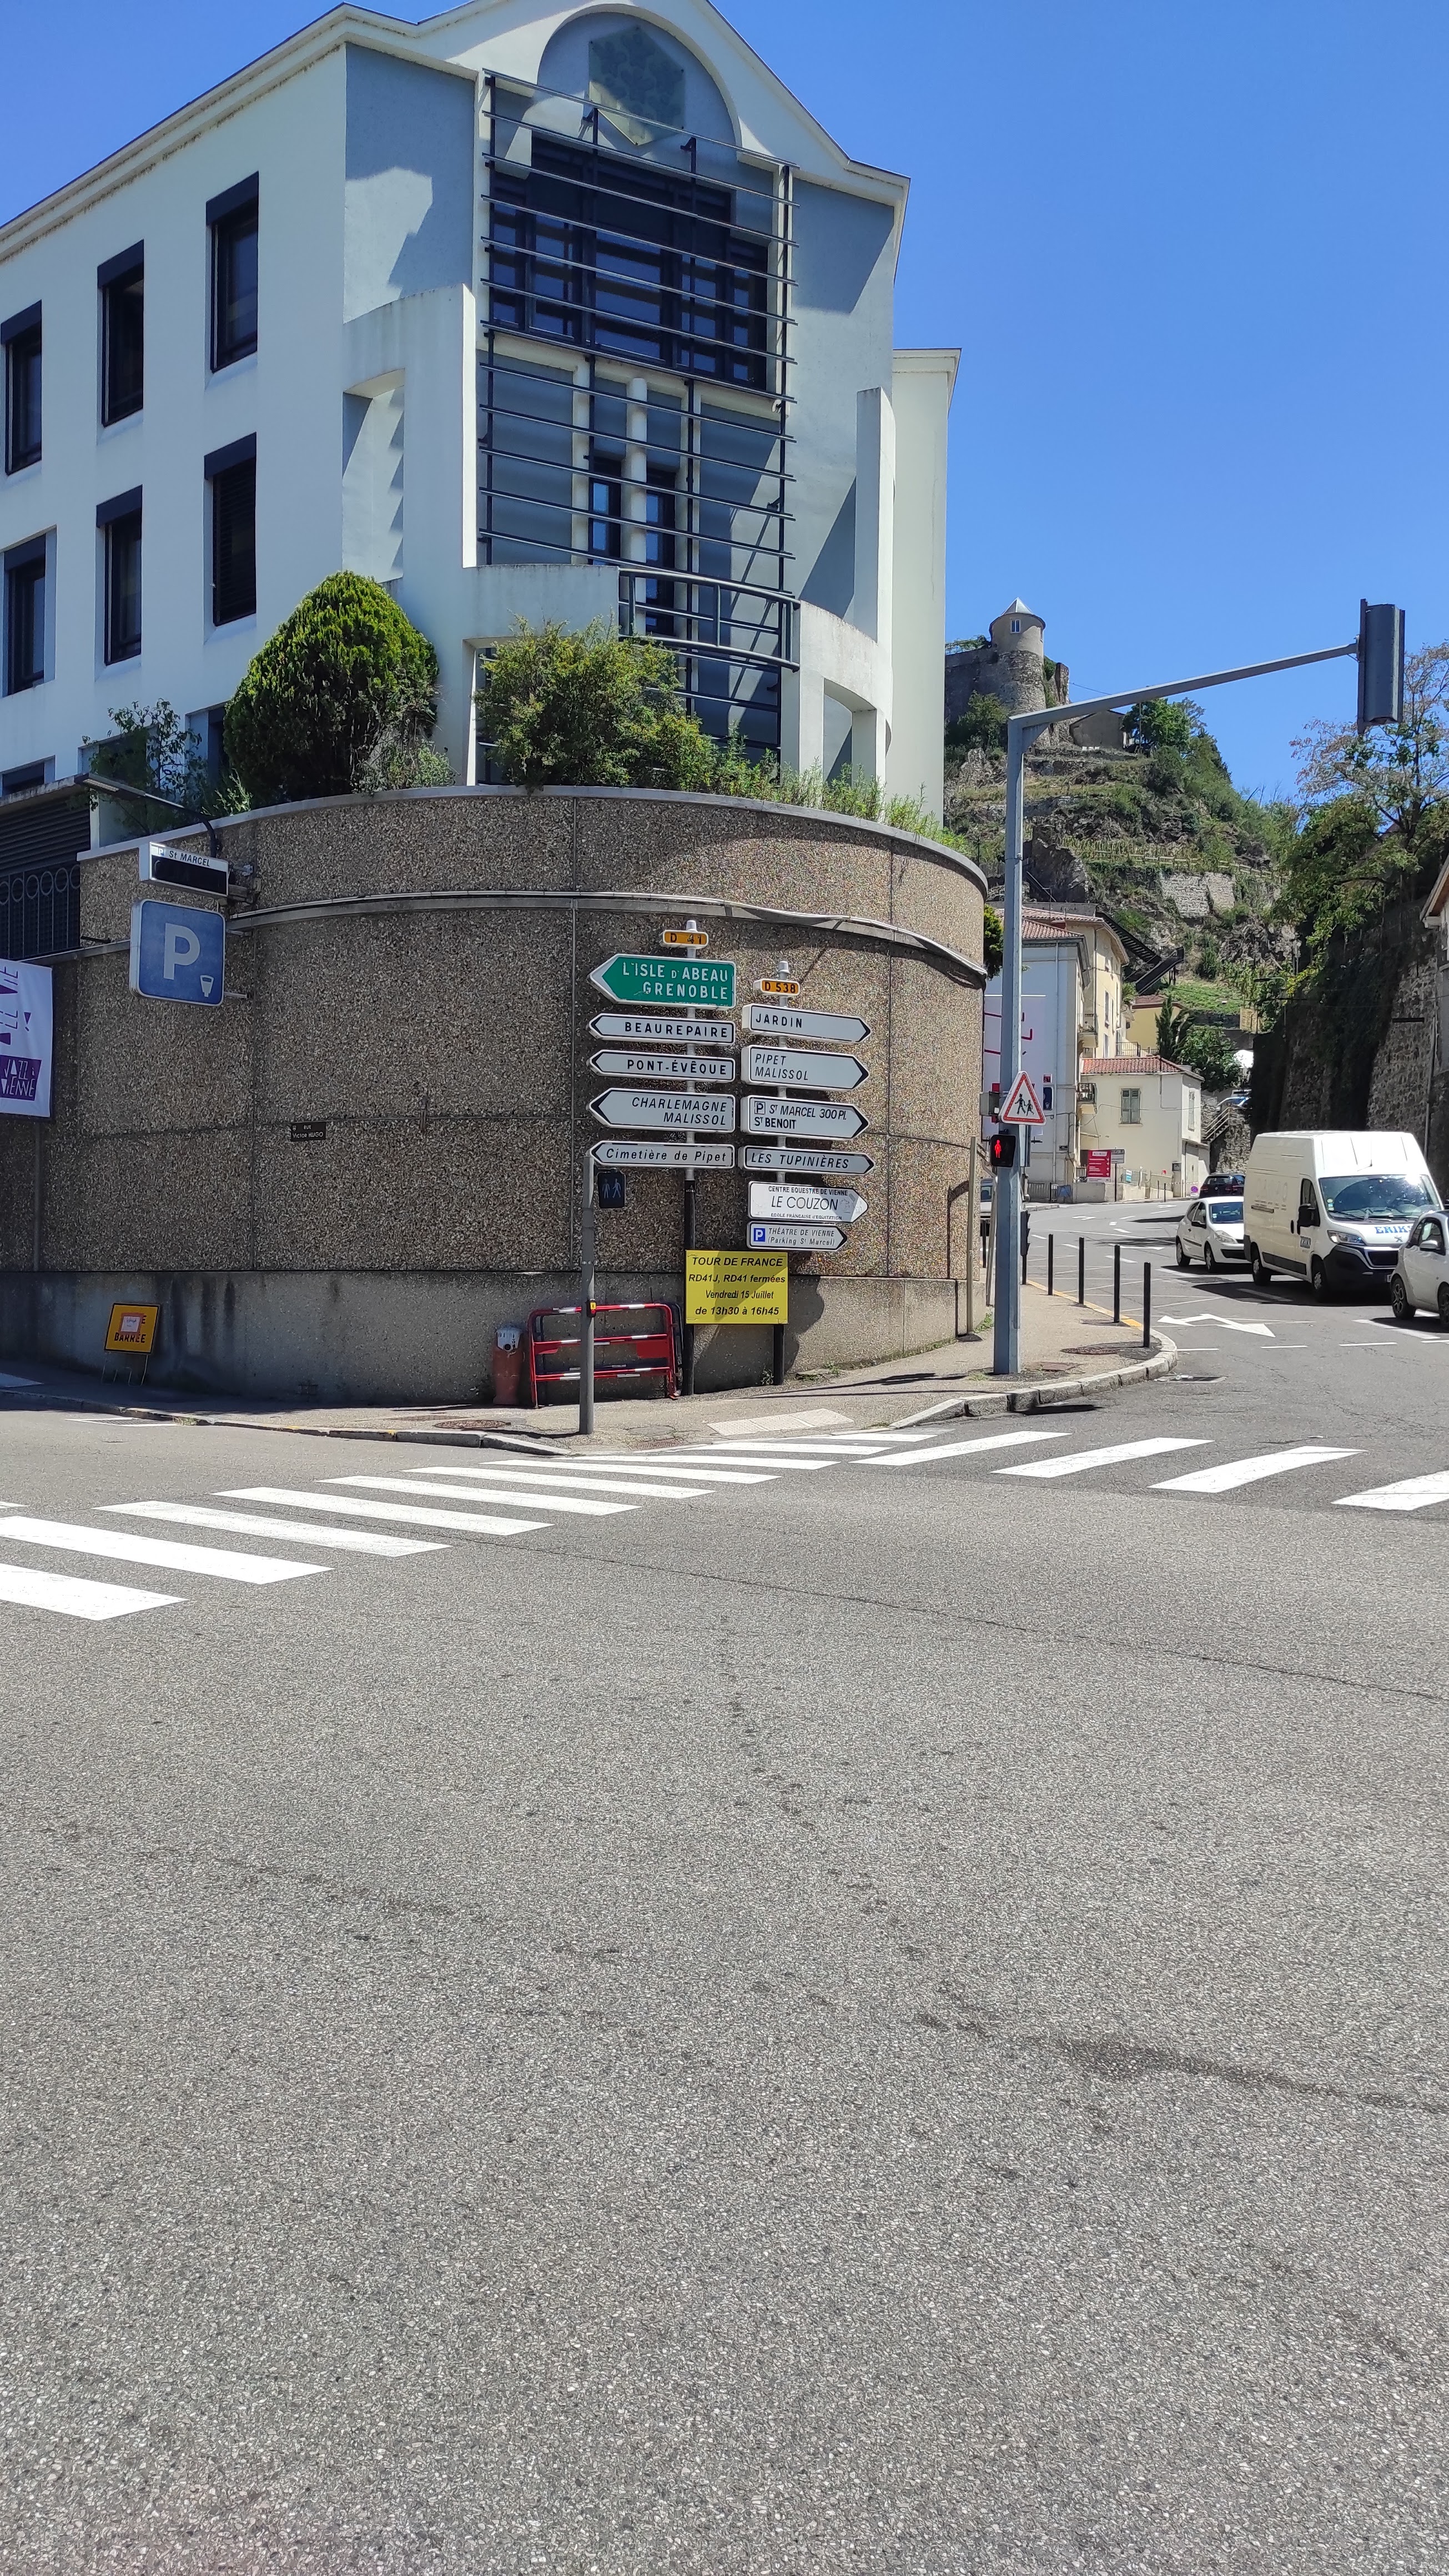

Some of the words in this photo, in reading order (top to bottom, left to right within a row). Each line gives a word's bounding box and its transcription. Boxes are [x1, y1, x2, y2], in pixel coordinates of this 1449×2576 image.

[169, 850, 177, 859] St
[180, 852, 210, 867] MARCEL
[670, 933, 677, 943] D
[687, 934, 702, 944] 41
[163, 923, 200, 980] P
[622, 961, 666, 978] L'ISLE
[642, 981, 728, 1000] GRENOBLE
[764, 982, 771, 992] D
[776, 983, 796, 993] 538
[756, 1013, 802, 1028] JARDIN
[625, 1022, 727, 1038] BEAUREPAIRE
[755, 1053, 787, 1066] PIPET
[4, 1059, 28, 1080] JAZZ
[627, 1059, 727, 1075] PONT-ÉVÊQUE
[754, 1066, 808, 1080] MALISSOL
[1, 1076, 36, 1097] VIENNE
[632, 1096, 727, 1112] CHARLEMAGNE
[756, 1103, 764, 1114] P
[780, 1105, 816, 1118] MARCEL
[819, 1109, 837, 1119] 300
[663, 1112, 726, 1125] MALISSOL
[765, 1118, 797, 1130] BENOIT
[606, 1148, 667, 1160] Cimetière
[675, 1150, 688, 1161] de
[695, 1151, 726, 1163] Pipet
[751, 1152, 772, 1164] LES
[779, 1154, 849, 1169] TUPINIÈRES
[771, 1196, 783, 1208] LE
[787, 1196, 838, 1210] COUZON
[755, 1229, 763, 1241] P
[768, 1236, 797, 1246] (Parking
[809, 1237, 835, 1246] Marcel)
[692, 1257, 721, 1266] TOUR
[723, 1257, 738, 1266] DE
[741, 1258, 783, 1267] FRANCE
[688, 1274, 720, 1284] RD41J,
[723, 1274, 747, 1282] RD41
[749, 1274, 786, 1283] fermées
[706, 1289, 739, 1299] Vendredi
[741, 1290, 749, 1299] 15
[751, 1290, 774, 1299] Juillet
[695, 1306, 707, 1315] de
[711, 1306, 739, 1315] 13h30
[742, 1306, 748, 1315] à
[751, 1306, 780, 1316] 16h45
